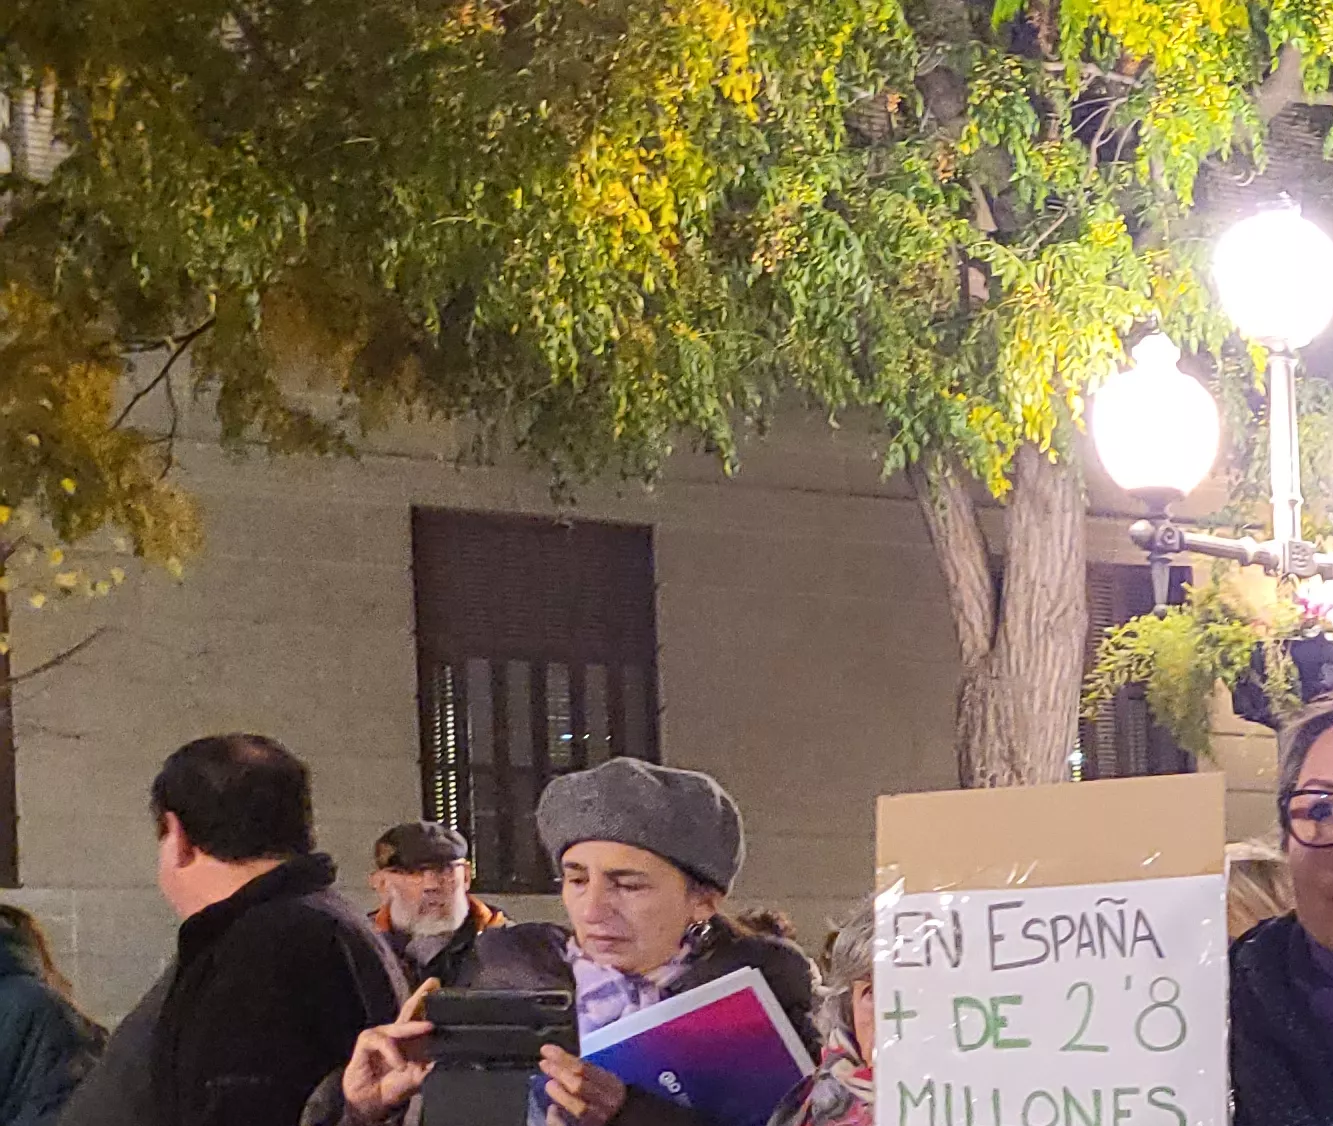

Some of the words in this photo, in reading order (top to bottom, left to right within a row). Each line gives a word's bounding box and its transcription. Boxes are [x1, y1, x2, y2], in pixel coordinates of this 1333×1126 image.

[893, 910, 963, 968] EN
[987, 897, 1165, 971] ESPAÑA
[883, 991, 918, 1041] +
[952, 994, 1032, 1052] DE
